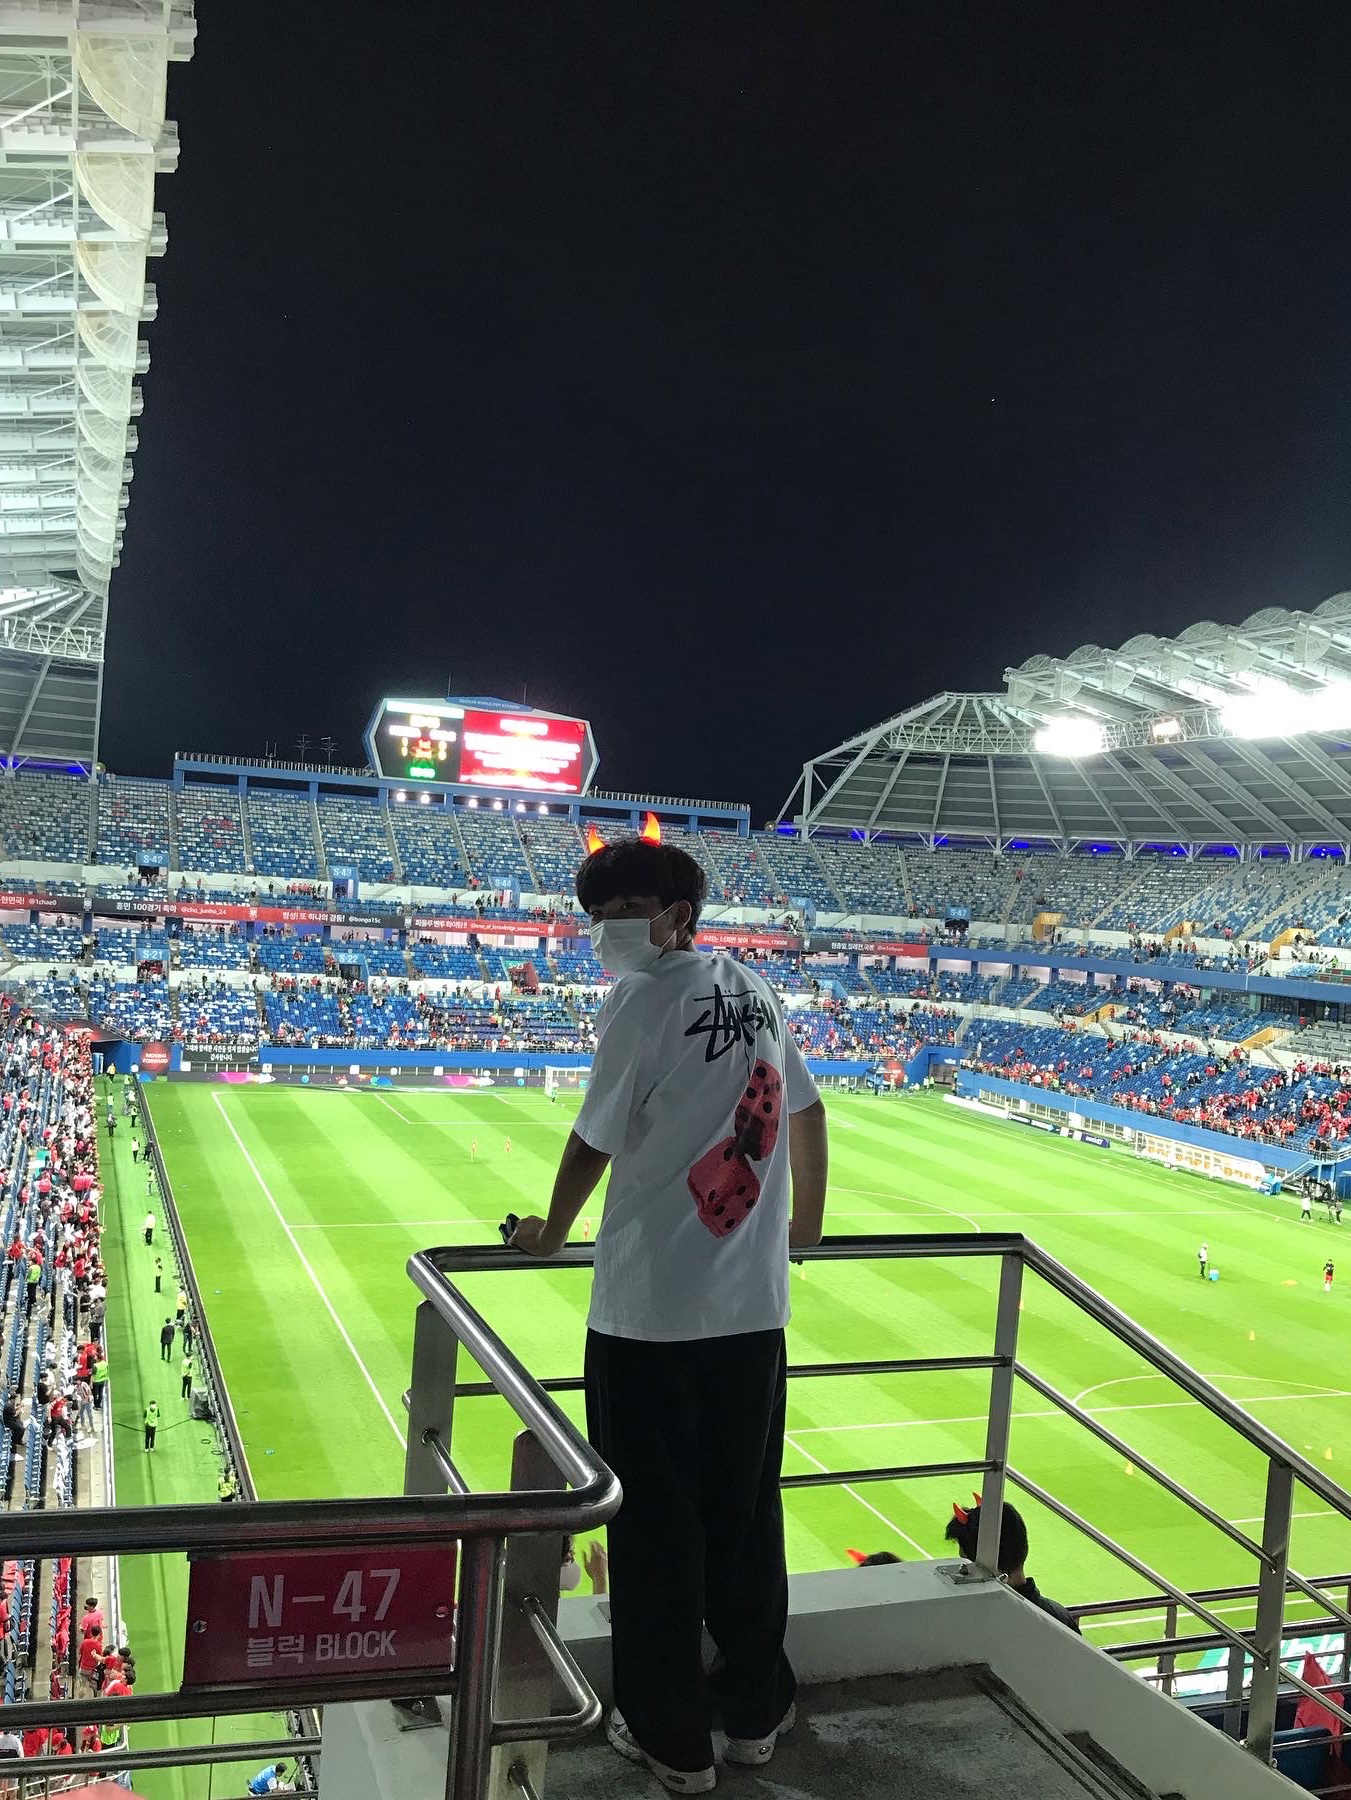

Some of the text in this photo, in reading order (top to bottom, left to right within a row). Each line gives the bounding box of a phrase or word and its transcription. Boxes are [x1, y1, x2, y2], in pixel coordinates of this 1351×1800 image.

[0, 896, 25, 905] 한민국!
[132, 903, 161, 912] 100경기
[247, 1630, 397, 1668] 블럭 BLOCK
